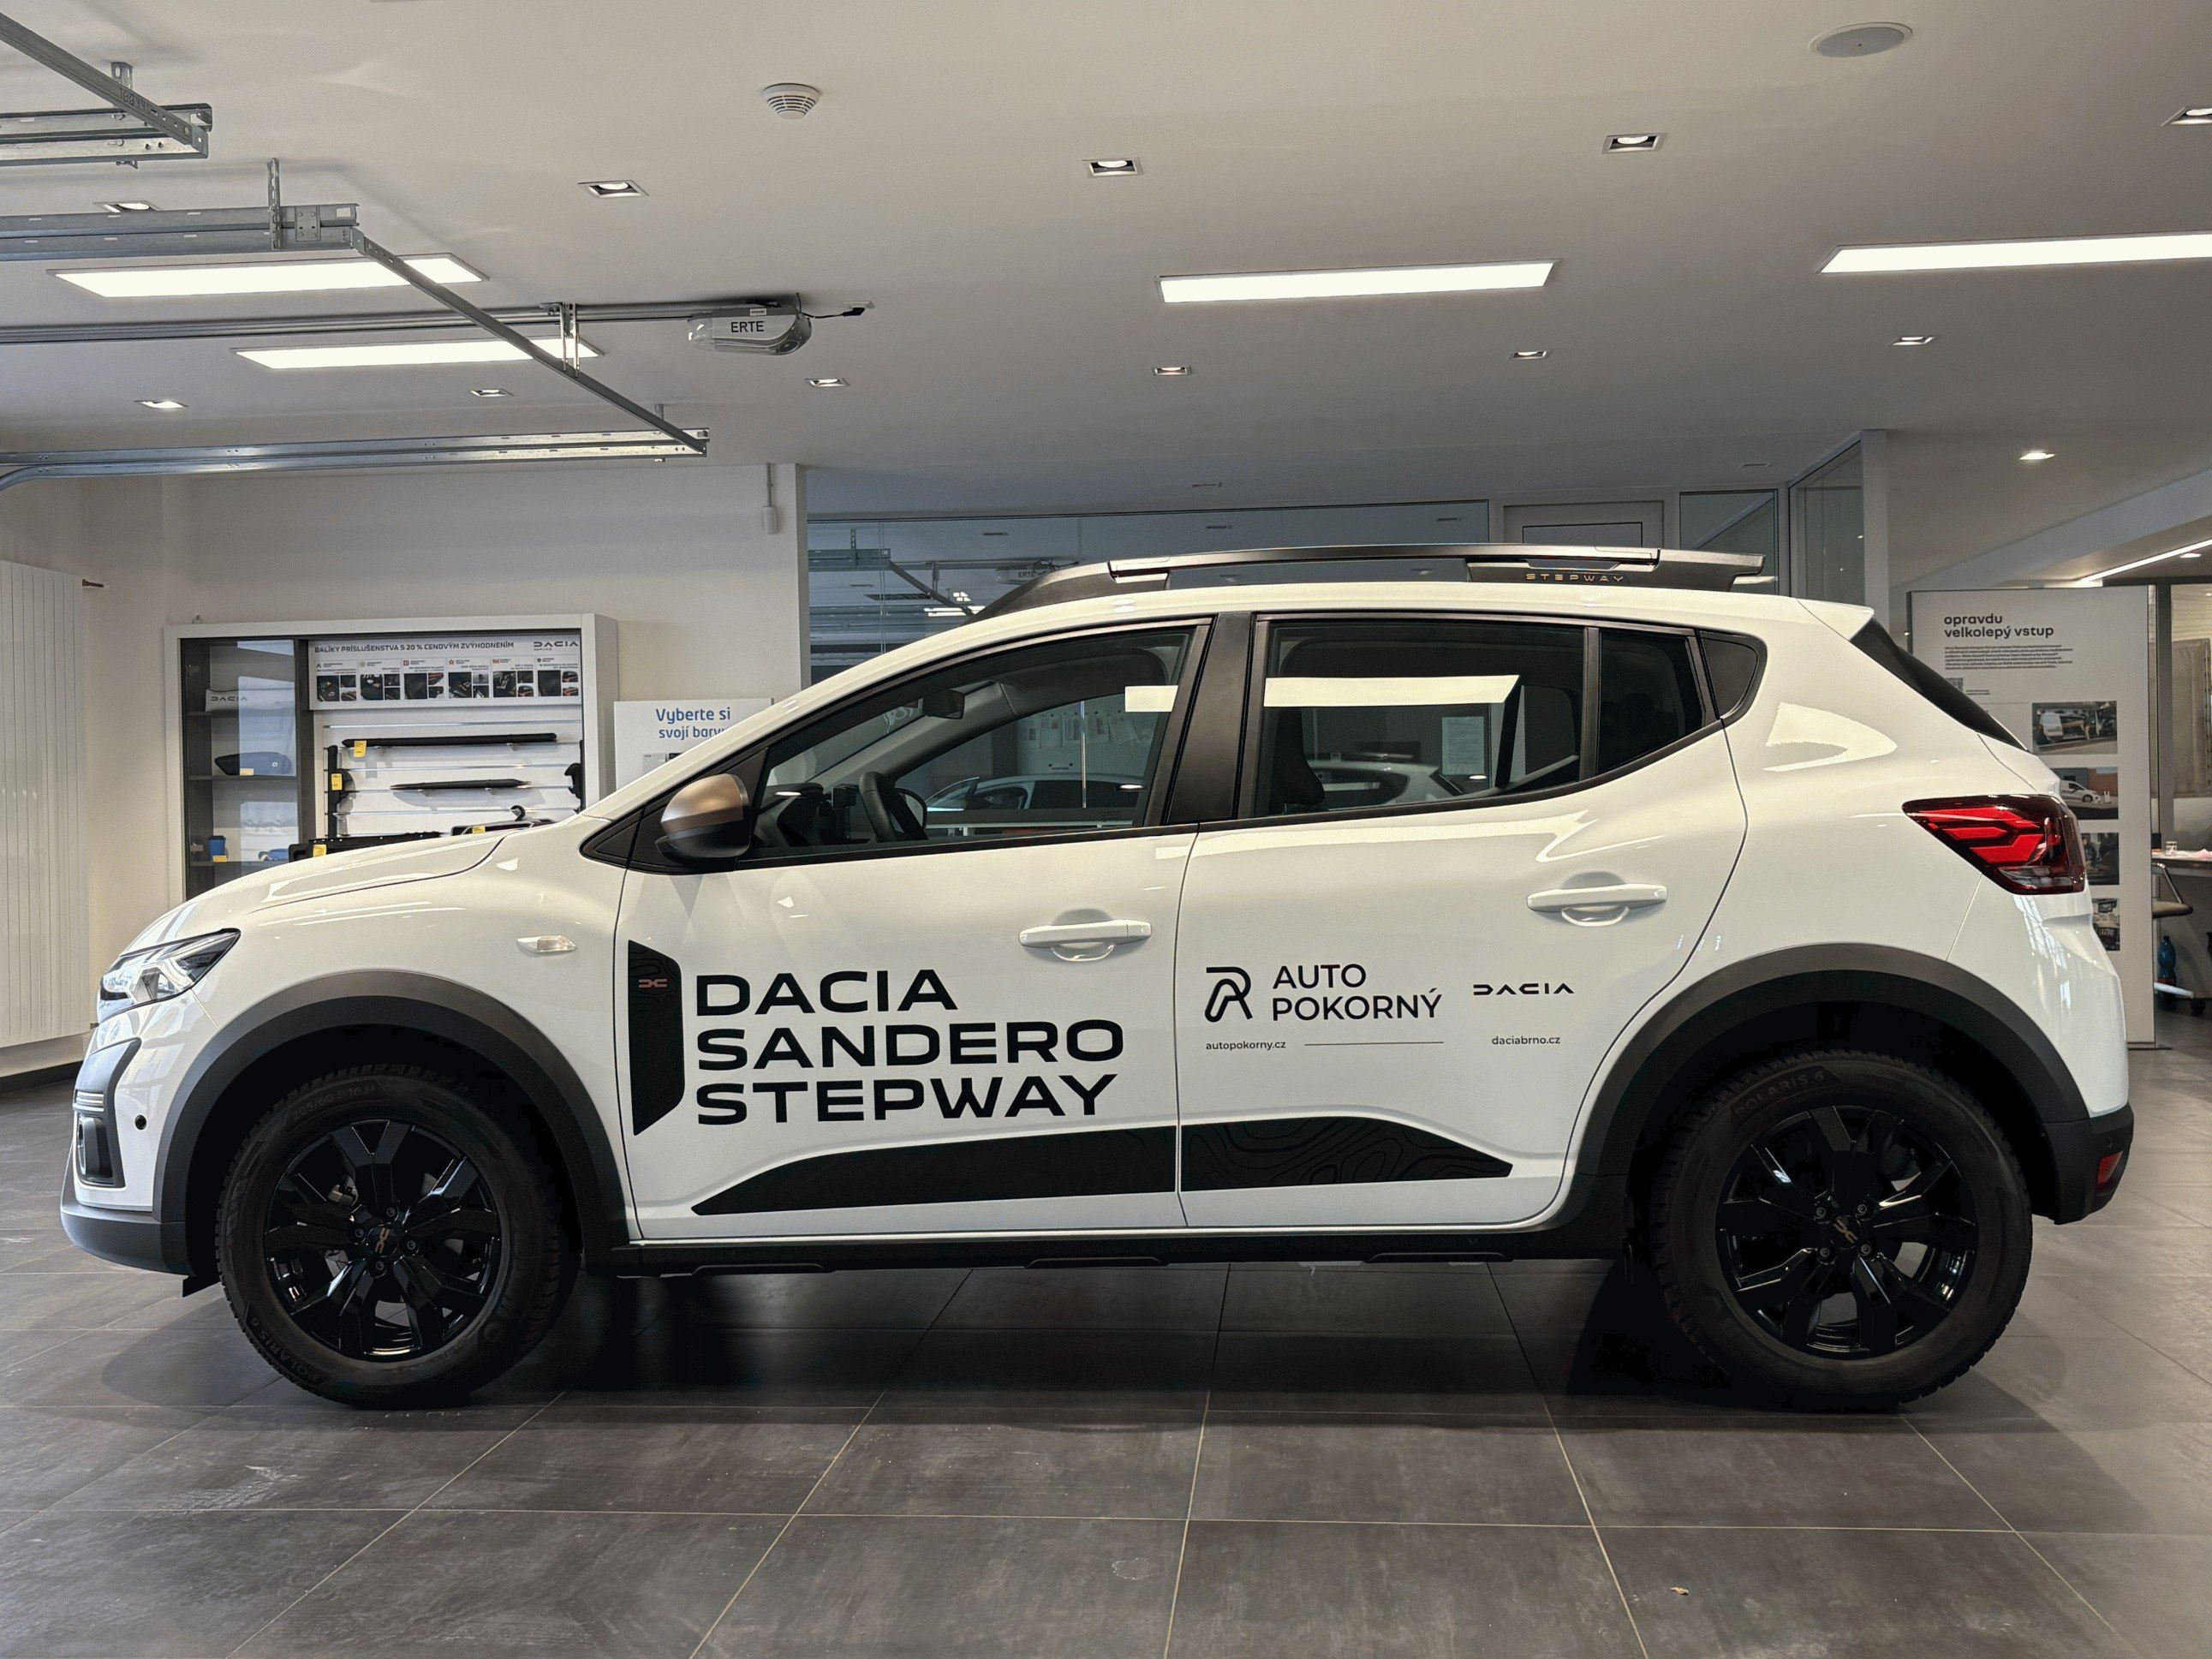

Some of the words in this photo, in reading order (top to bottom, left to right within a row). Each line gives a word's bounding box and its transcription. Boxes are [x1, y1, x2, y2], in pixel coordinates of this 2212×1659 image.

[731, 320, 764, 332] ERTE
[1525, 573, 1625, 582] STEPWAY
[1944, 613, 2002, 627] opravdu
[1944, 625, 2012, 639] velkolepý
[2014, 626, 2054, 639] vstup
[656, 707, 714, 724] Vyberte
[719, 707, 730, 720] si
[659, 725, 689, 741] svojí
[1273, 964, 1367, 989] AUTO
[696, 969, 958, 1017] DACIA
[1473, 982, 1575, 996] DACIA
[1273, 988, 1442, 1022] POKORNÝ
[697, 1018, 1124, 1071] SANDERO
[1206, 1040, 1286, 1051] autopokorny.cz
[1492, 1035, 1561, 1046] daciabrno.cz
[697, 1073, 1118, 1125] STEPWAY
